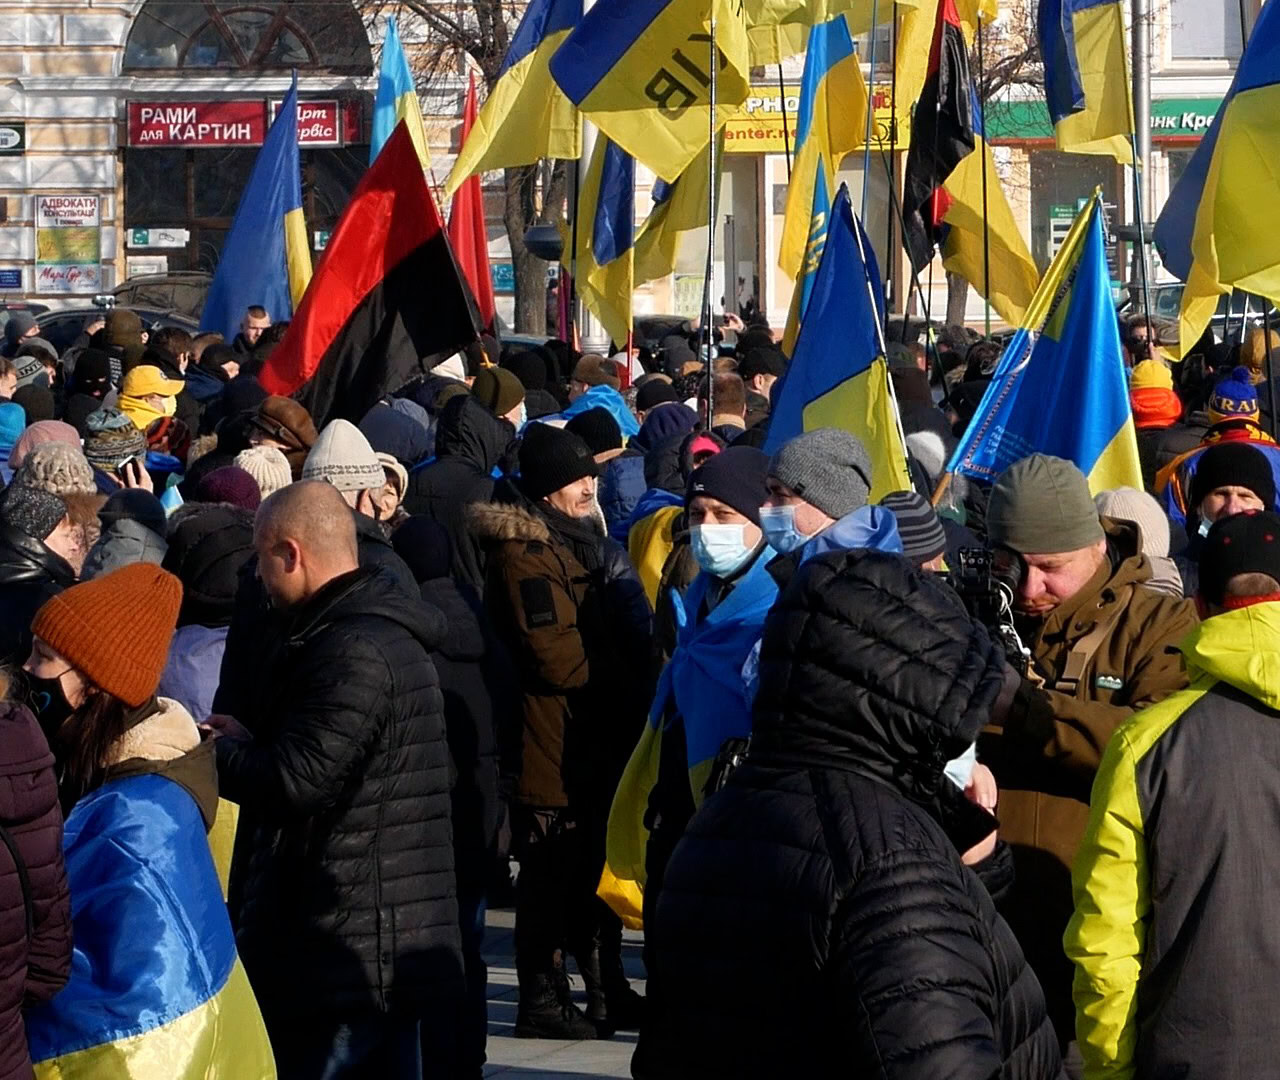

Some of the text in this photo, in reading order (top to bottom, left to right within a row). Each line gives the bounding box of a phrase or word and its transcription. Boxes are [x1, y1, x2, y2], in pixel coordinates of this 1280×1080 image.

[140, 107, 197, 124] РАМИ
[169, 123, 252, 141] КАРТИН
[299, 124, 333, 139] рвіс
[40, 198, 97, 210] АДВОКАТИ
